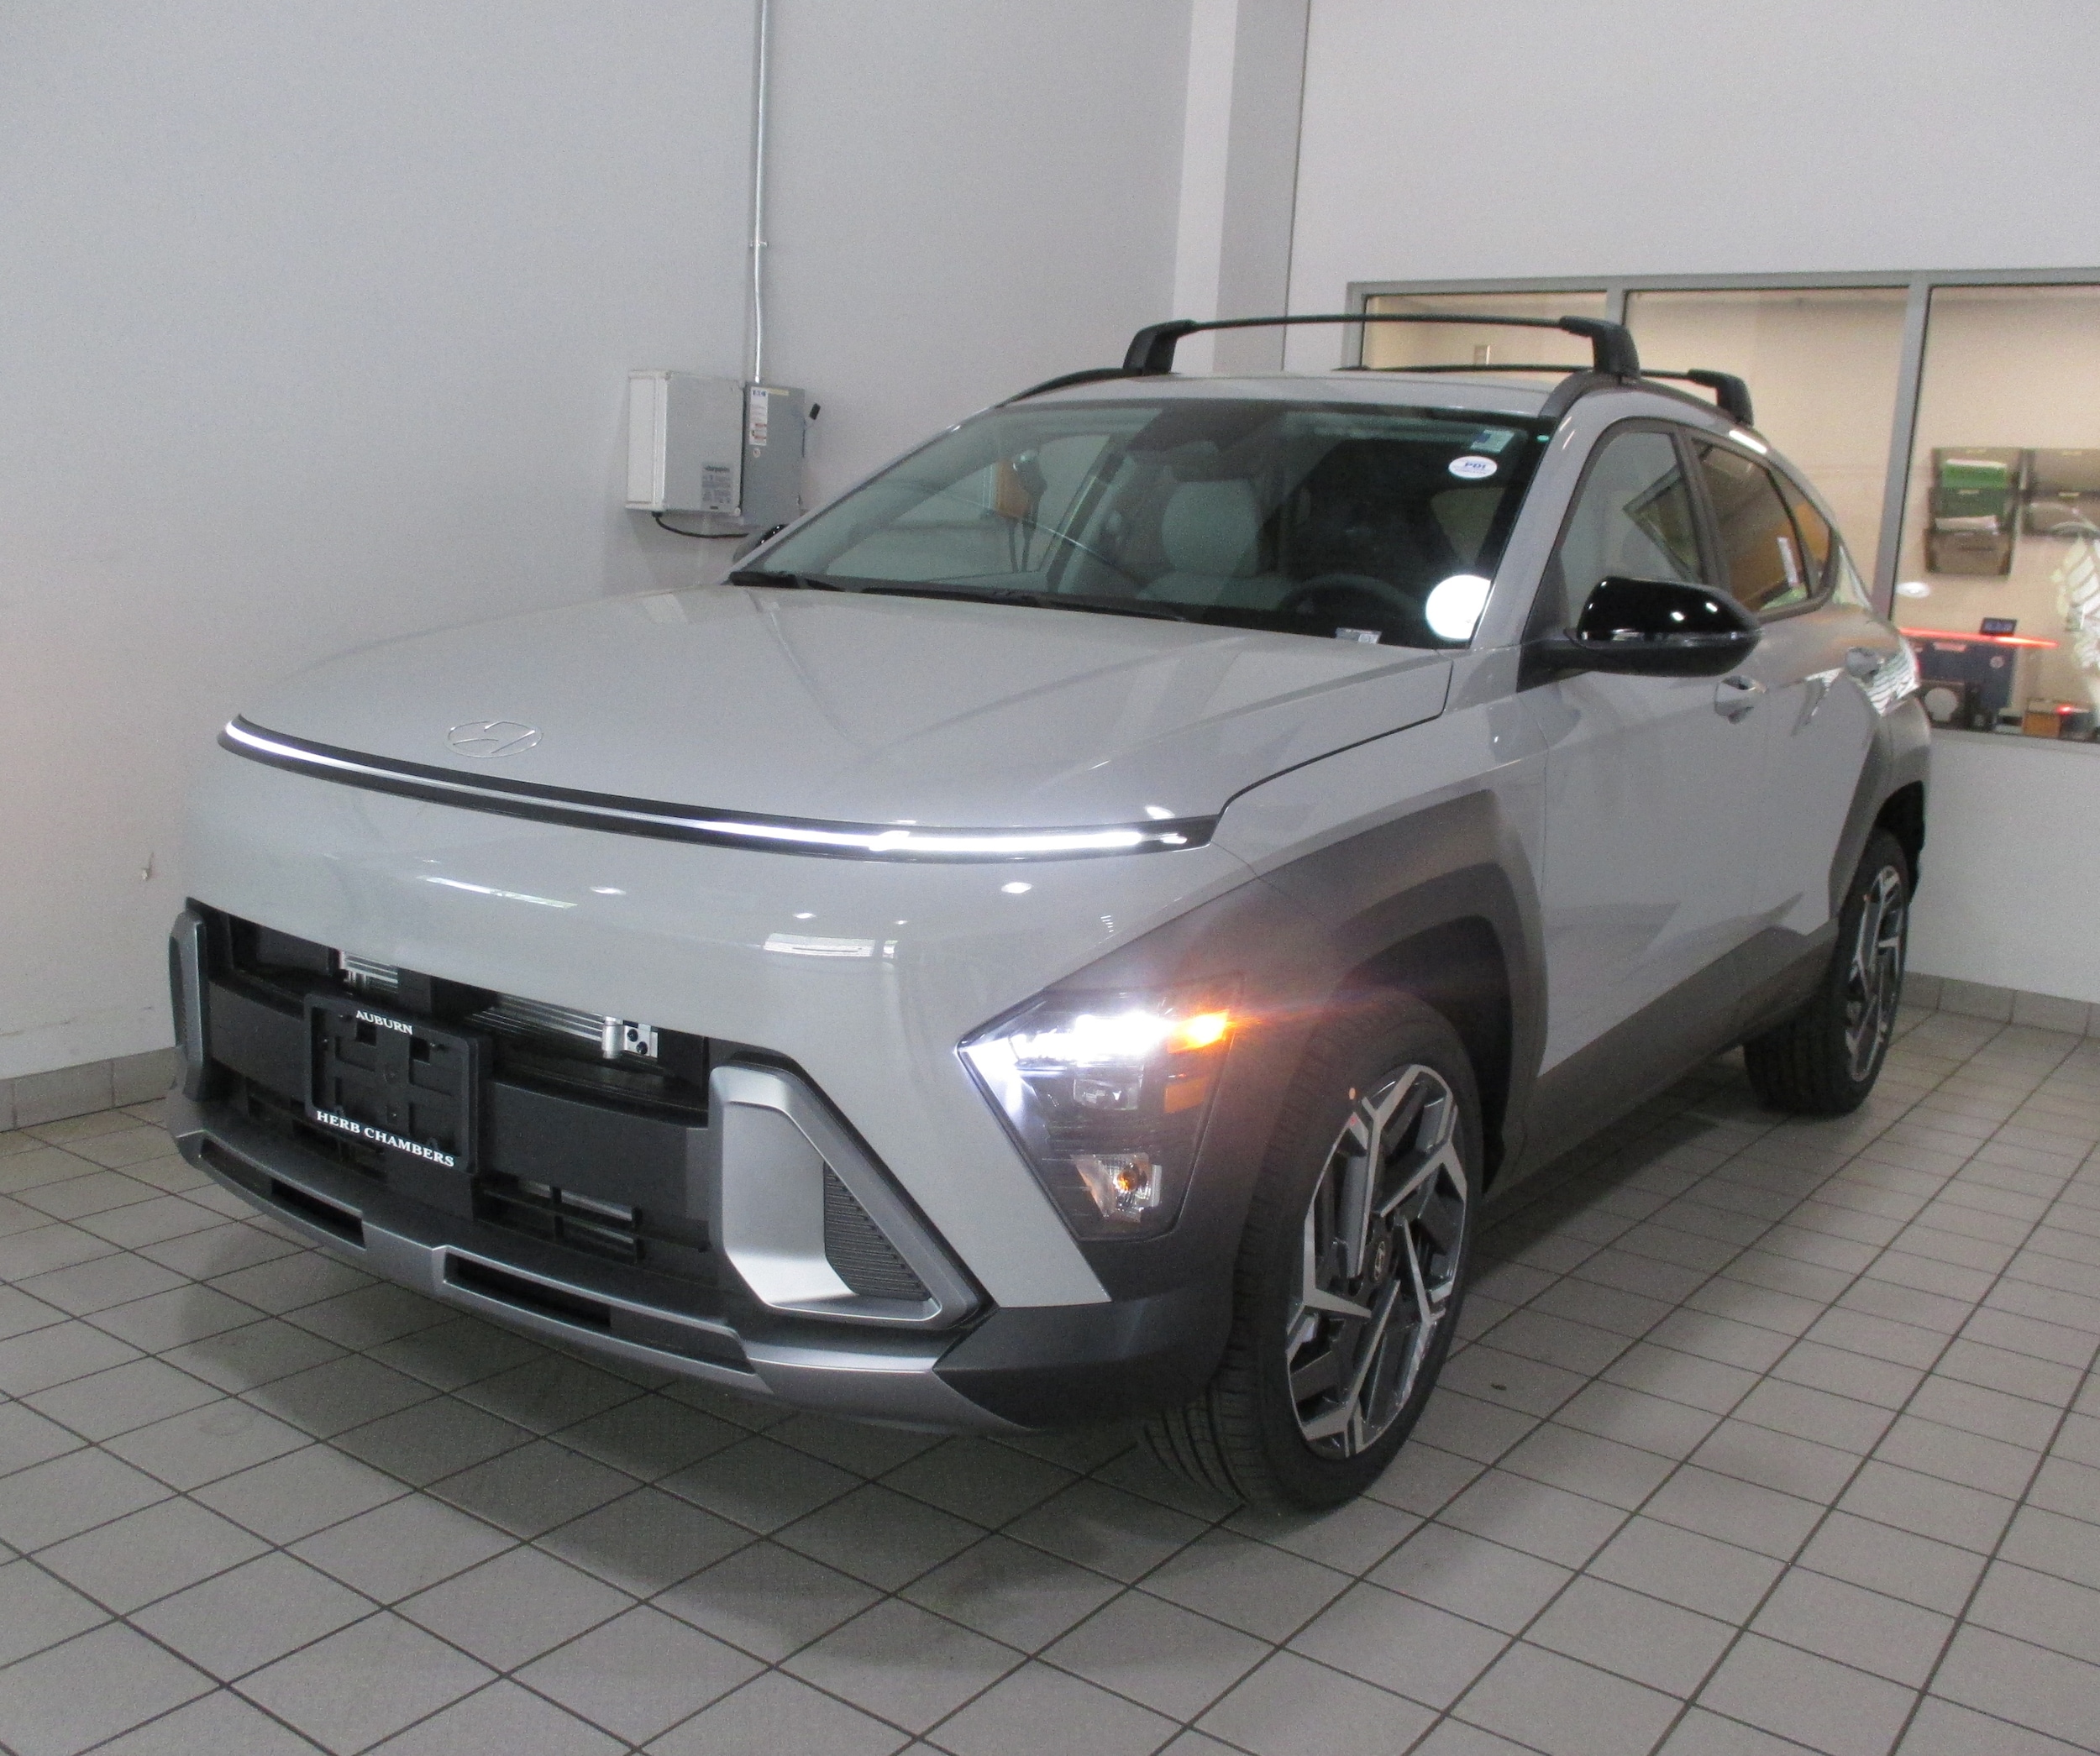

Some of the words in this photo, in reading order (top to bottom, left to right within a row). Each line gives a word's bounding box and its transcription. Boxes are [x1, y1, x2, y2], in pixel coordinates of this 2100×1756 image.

[355, 1010, 413, 1035] AUBURN
[317, 1110, 360, 1134] HERB
[364, 1126, 455, 1167] CHAMBERS
